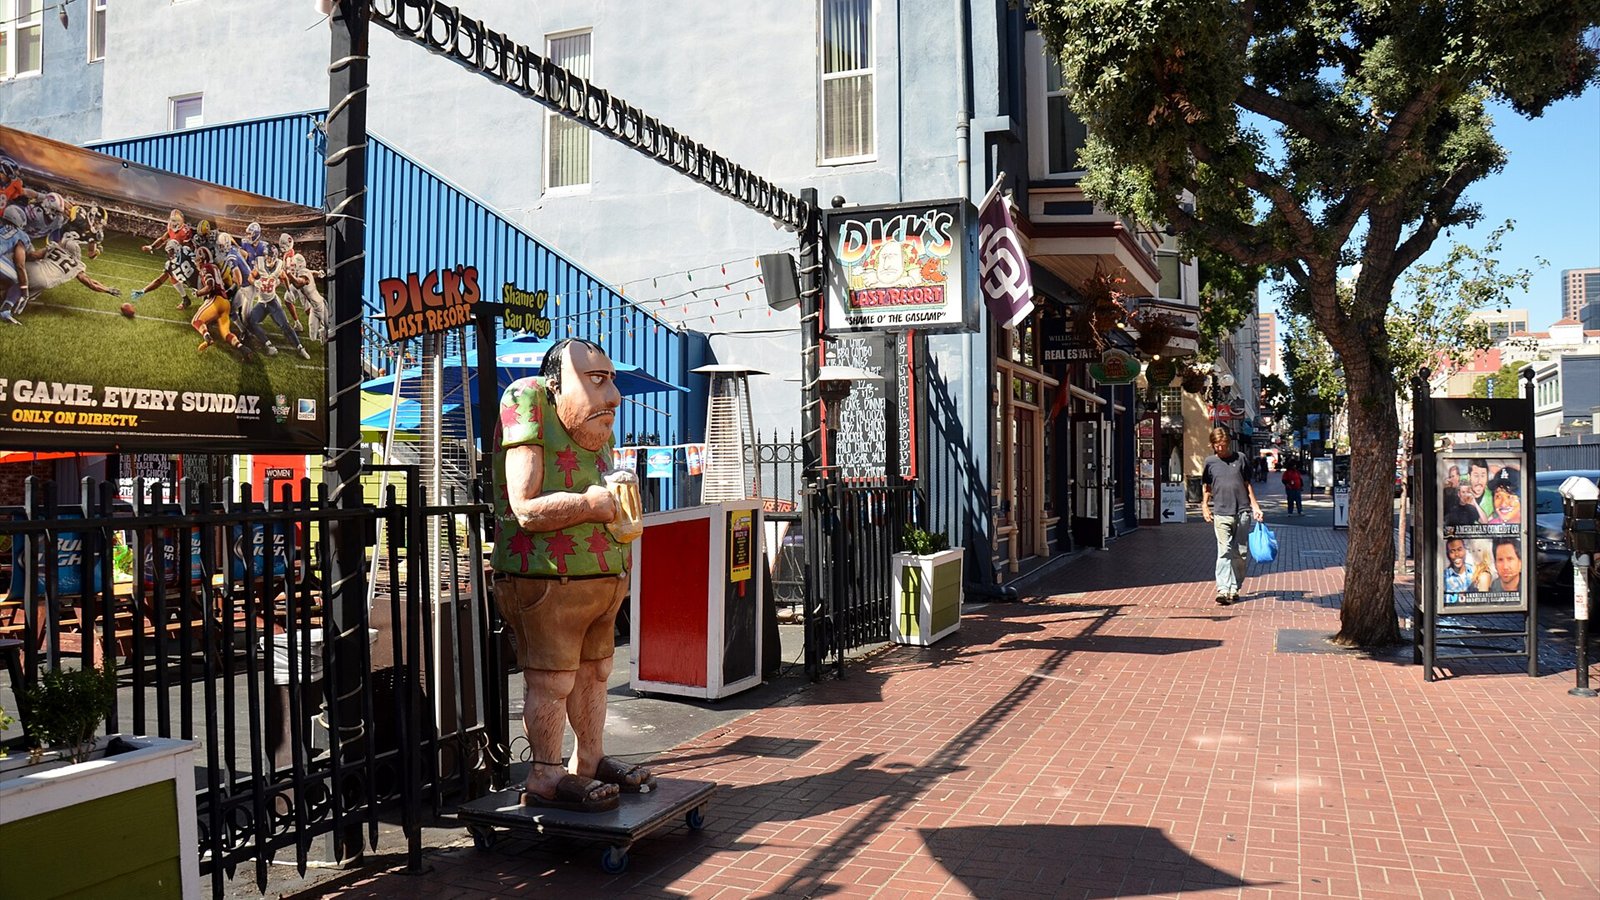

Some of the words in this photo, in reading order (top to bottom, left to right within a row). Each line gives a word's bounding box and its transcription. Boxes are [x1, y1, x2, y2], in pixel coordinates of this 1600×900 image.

[841, 210, 953, 262] DICK'S
[380, 265, 480, 317] DICK'S
[504, 284, 534, 308] Shame
[537, 291, 547, 309] O'
[850, 290, 888, 308] LAST
[888, 287, 942, 305] RESORT
[388, 315, 423, 341] LAST
[427, 303, 471, 331] RESORT
[505, 308, 522, 330] San
[525, 313, 551, 336] Diego
[877, 314, 886, 324] O'
[888, 313, 903, 323] THE
[1045, 350, 1066, 361] REAL
[13, 379, 98, 407] GAME.
[102, 386, 178, 411] EVERY
[181, 391, 261, 415] SUNDAY.
[11, 409, 53, 423] ONLY
[54, 411, 76, 424] ON
[77, 412, 138, 427] DIRECTV.
[266, 469, 291, 477] WOMEN
[1455, 525, 1487, 534] AMERICAN
[1488, 524, 1510, 533] COMEDY
